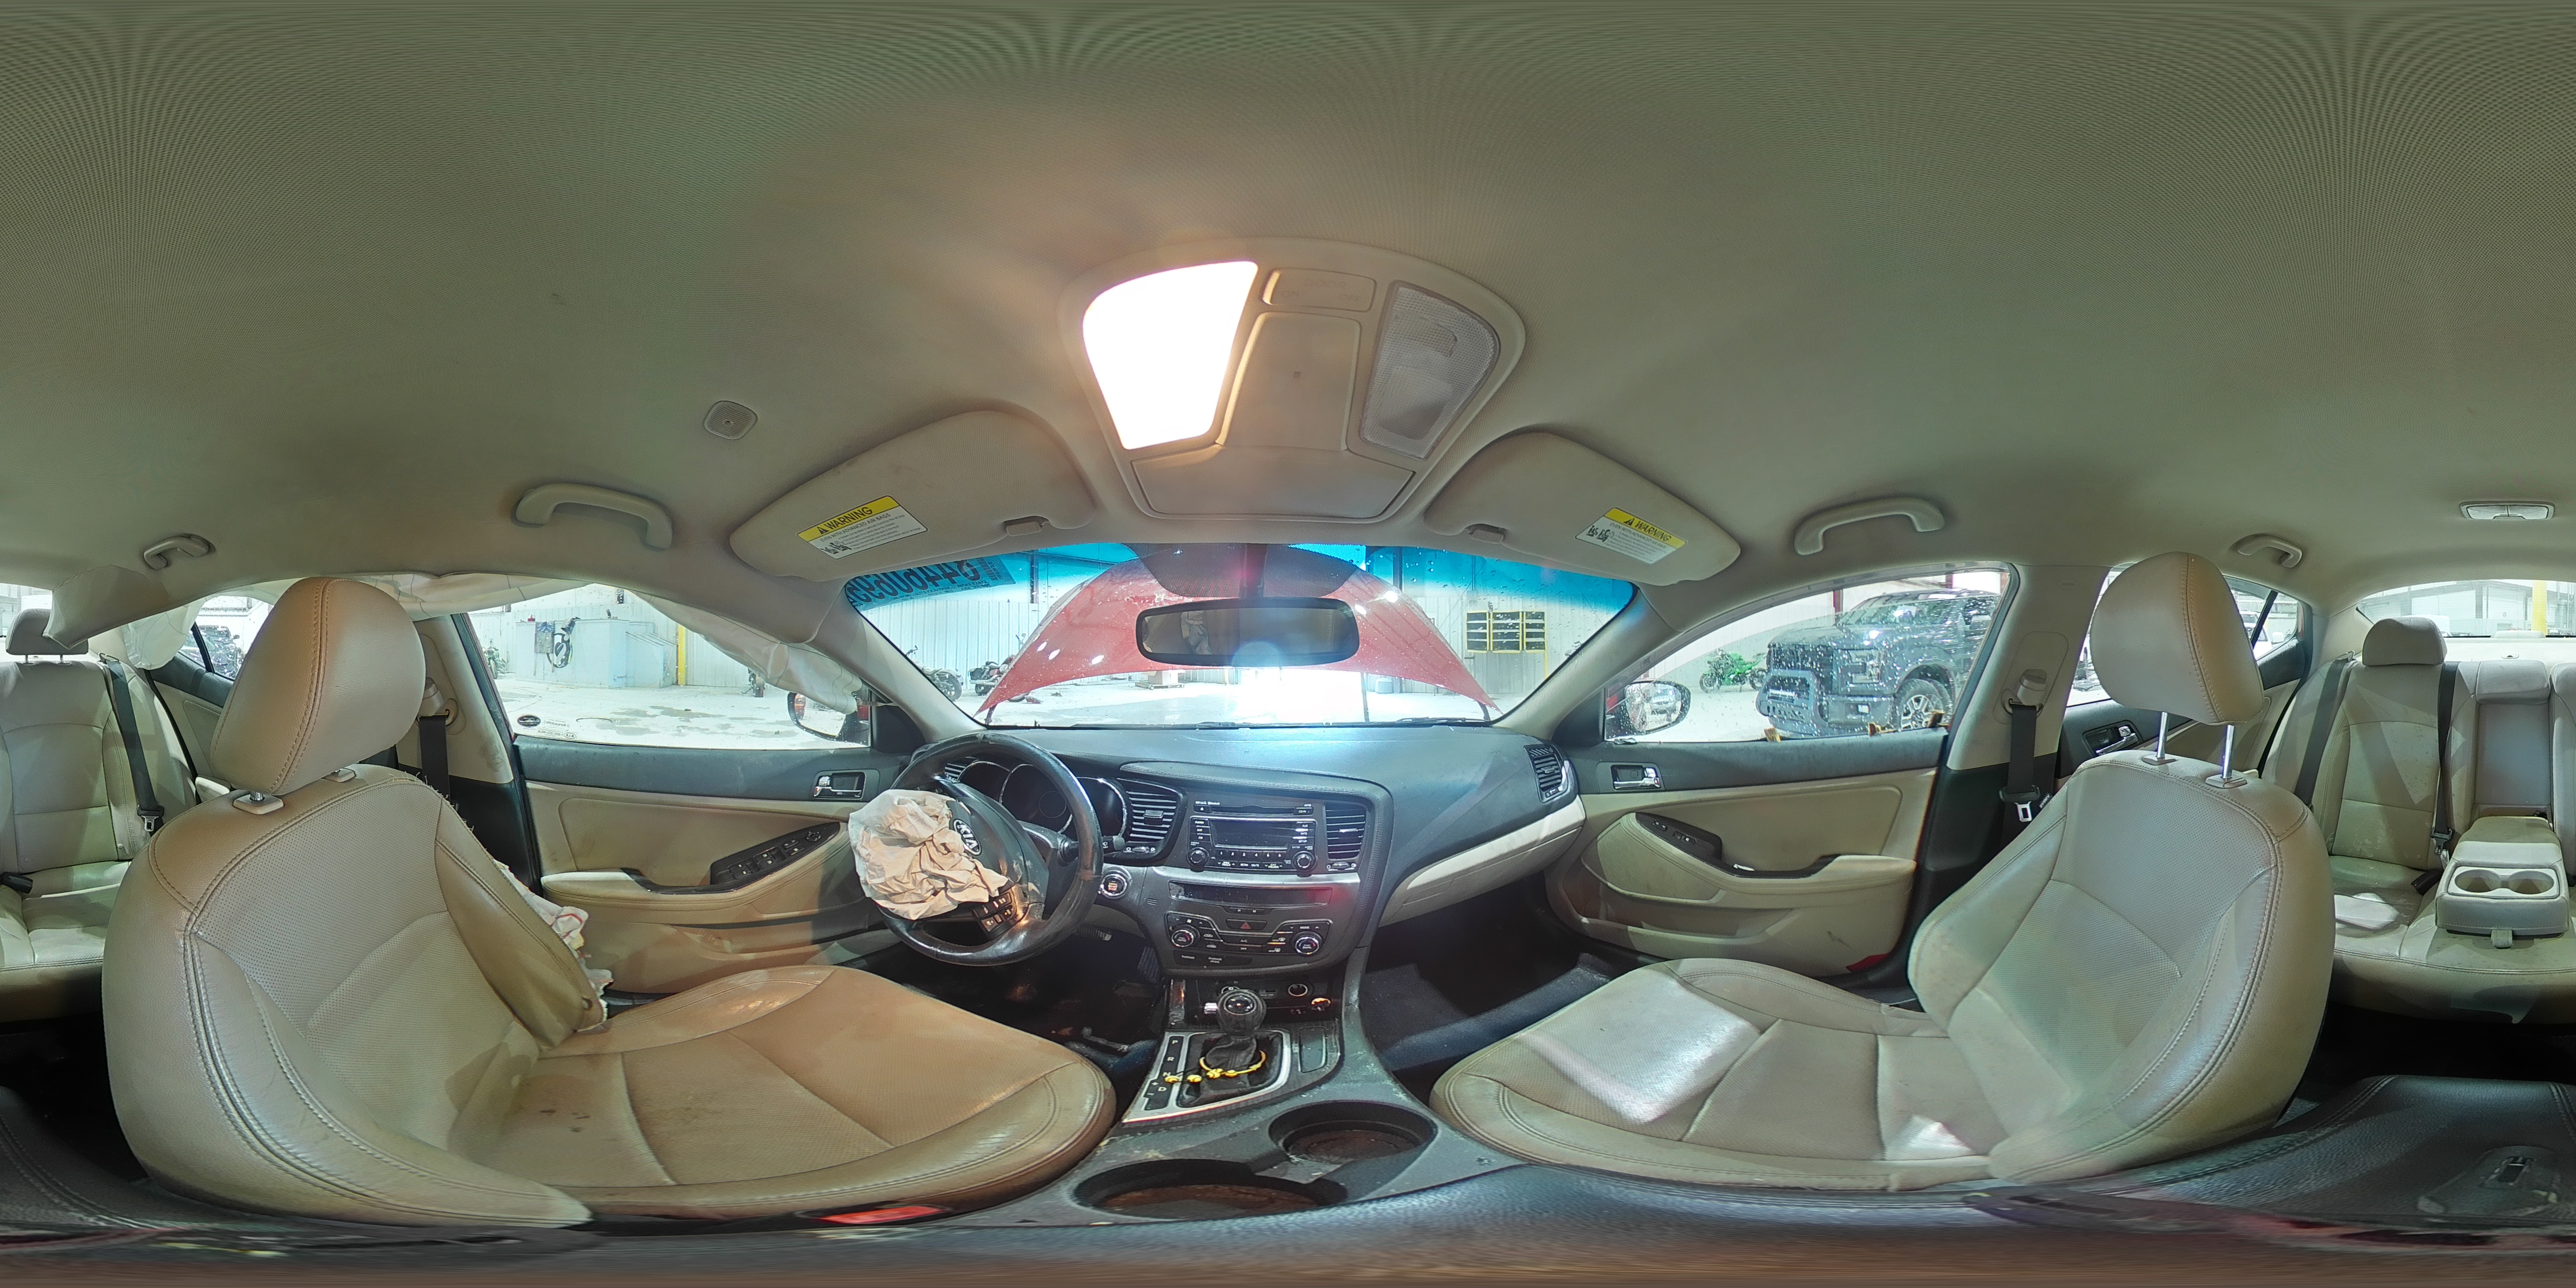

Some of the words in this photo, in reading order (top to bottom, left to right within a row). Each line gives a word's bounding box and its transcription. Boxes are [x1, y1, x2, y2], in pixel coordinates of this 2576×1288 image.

[825, 507, 873, 529] WARNING
[843, 521, 867, 534] ADVANCED
[877, 513, 891, 521] BAGS
[1635, 520, 1672, 542] WARNING
[956, 821, 979, 854] KIA
